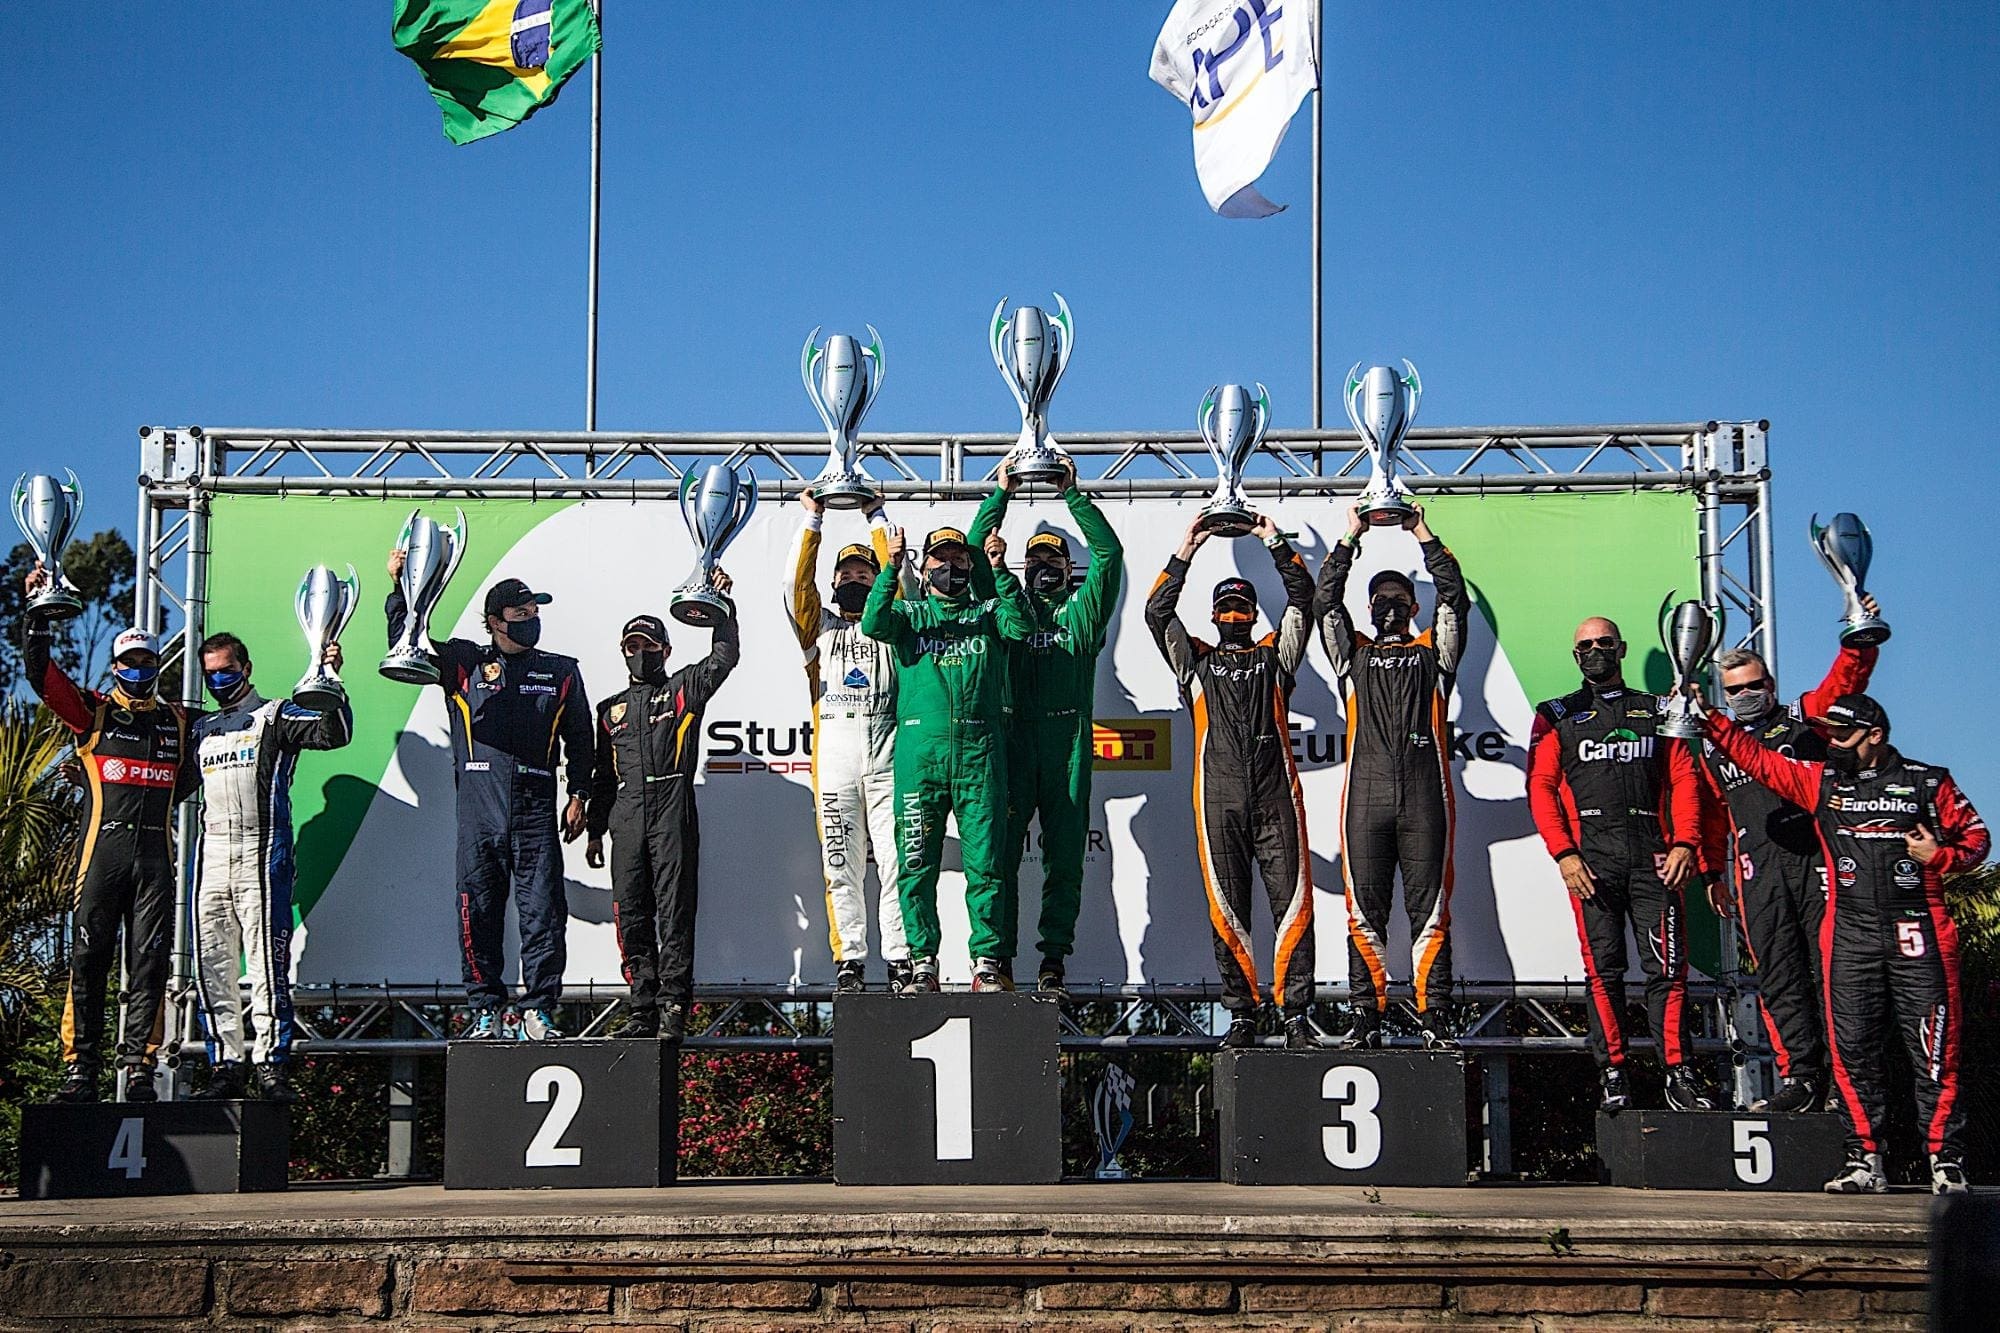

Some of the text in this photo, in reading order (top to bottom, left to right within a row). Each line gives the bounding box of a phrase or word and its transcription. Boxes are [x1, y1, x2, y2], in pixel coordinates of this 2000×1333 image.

[202, 748, 255, 768] SANTA FE
[708, 721, 814, 756] Stut
[1578, 736, 1654, 763] Cargill
[822, 792, 846, 867] IMPERIO
[903, 792, 923, 871] IMPERIO
[1841, 797, 1919, 813] Eurobike
[1740, 853, 1755, 881] 5
[1897, 921, 1926, 958] 5
[526, 1065, 583, 1167] 2
[910, 1017, 972, 1160] 1
[1321, 1065, 1381, 1170] 3
[108, 1118, 146, 1179] 4
[1732, 1120, 1774, 1184] 5
